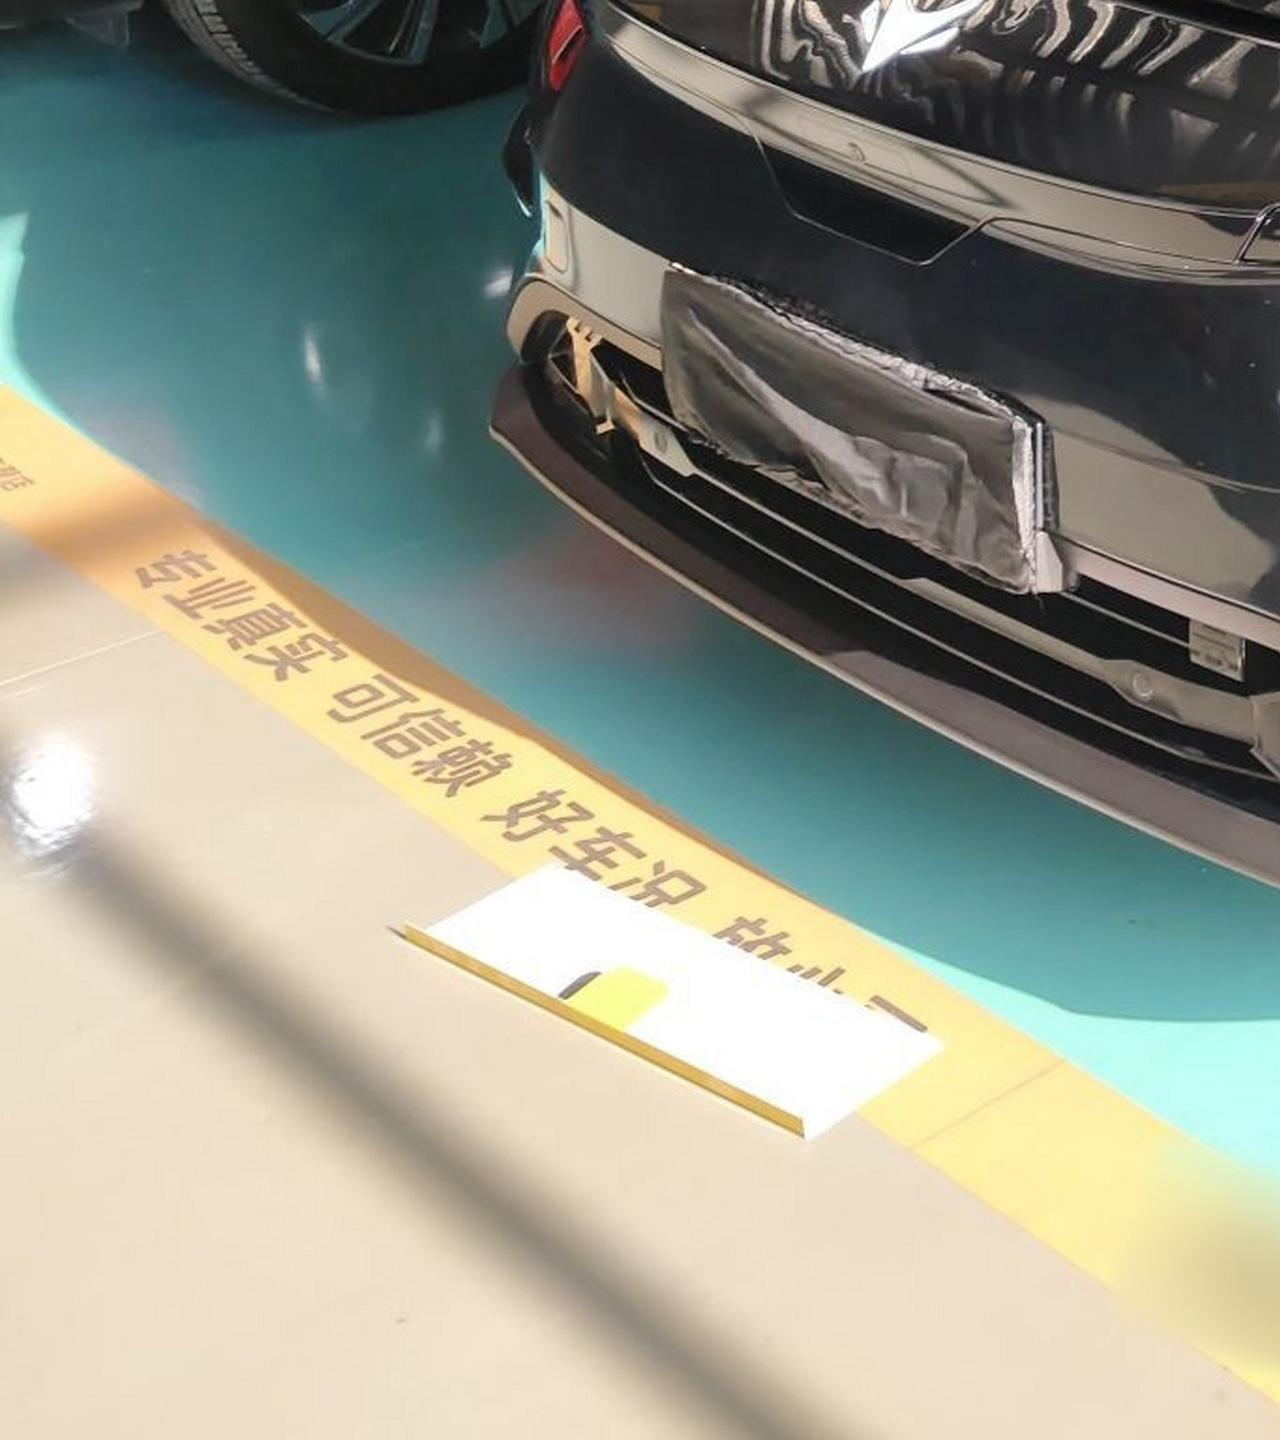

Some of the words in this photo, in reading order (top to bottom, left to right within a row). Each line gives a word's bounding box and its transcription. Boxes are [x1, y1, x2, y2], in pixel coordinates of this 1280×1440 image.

[135, 550, 349, 682] 专业真实
[326, 673, 513, 798] 可信赖
[480, 788, 708, 908] 好车况
